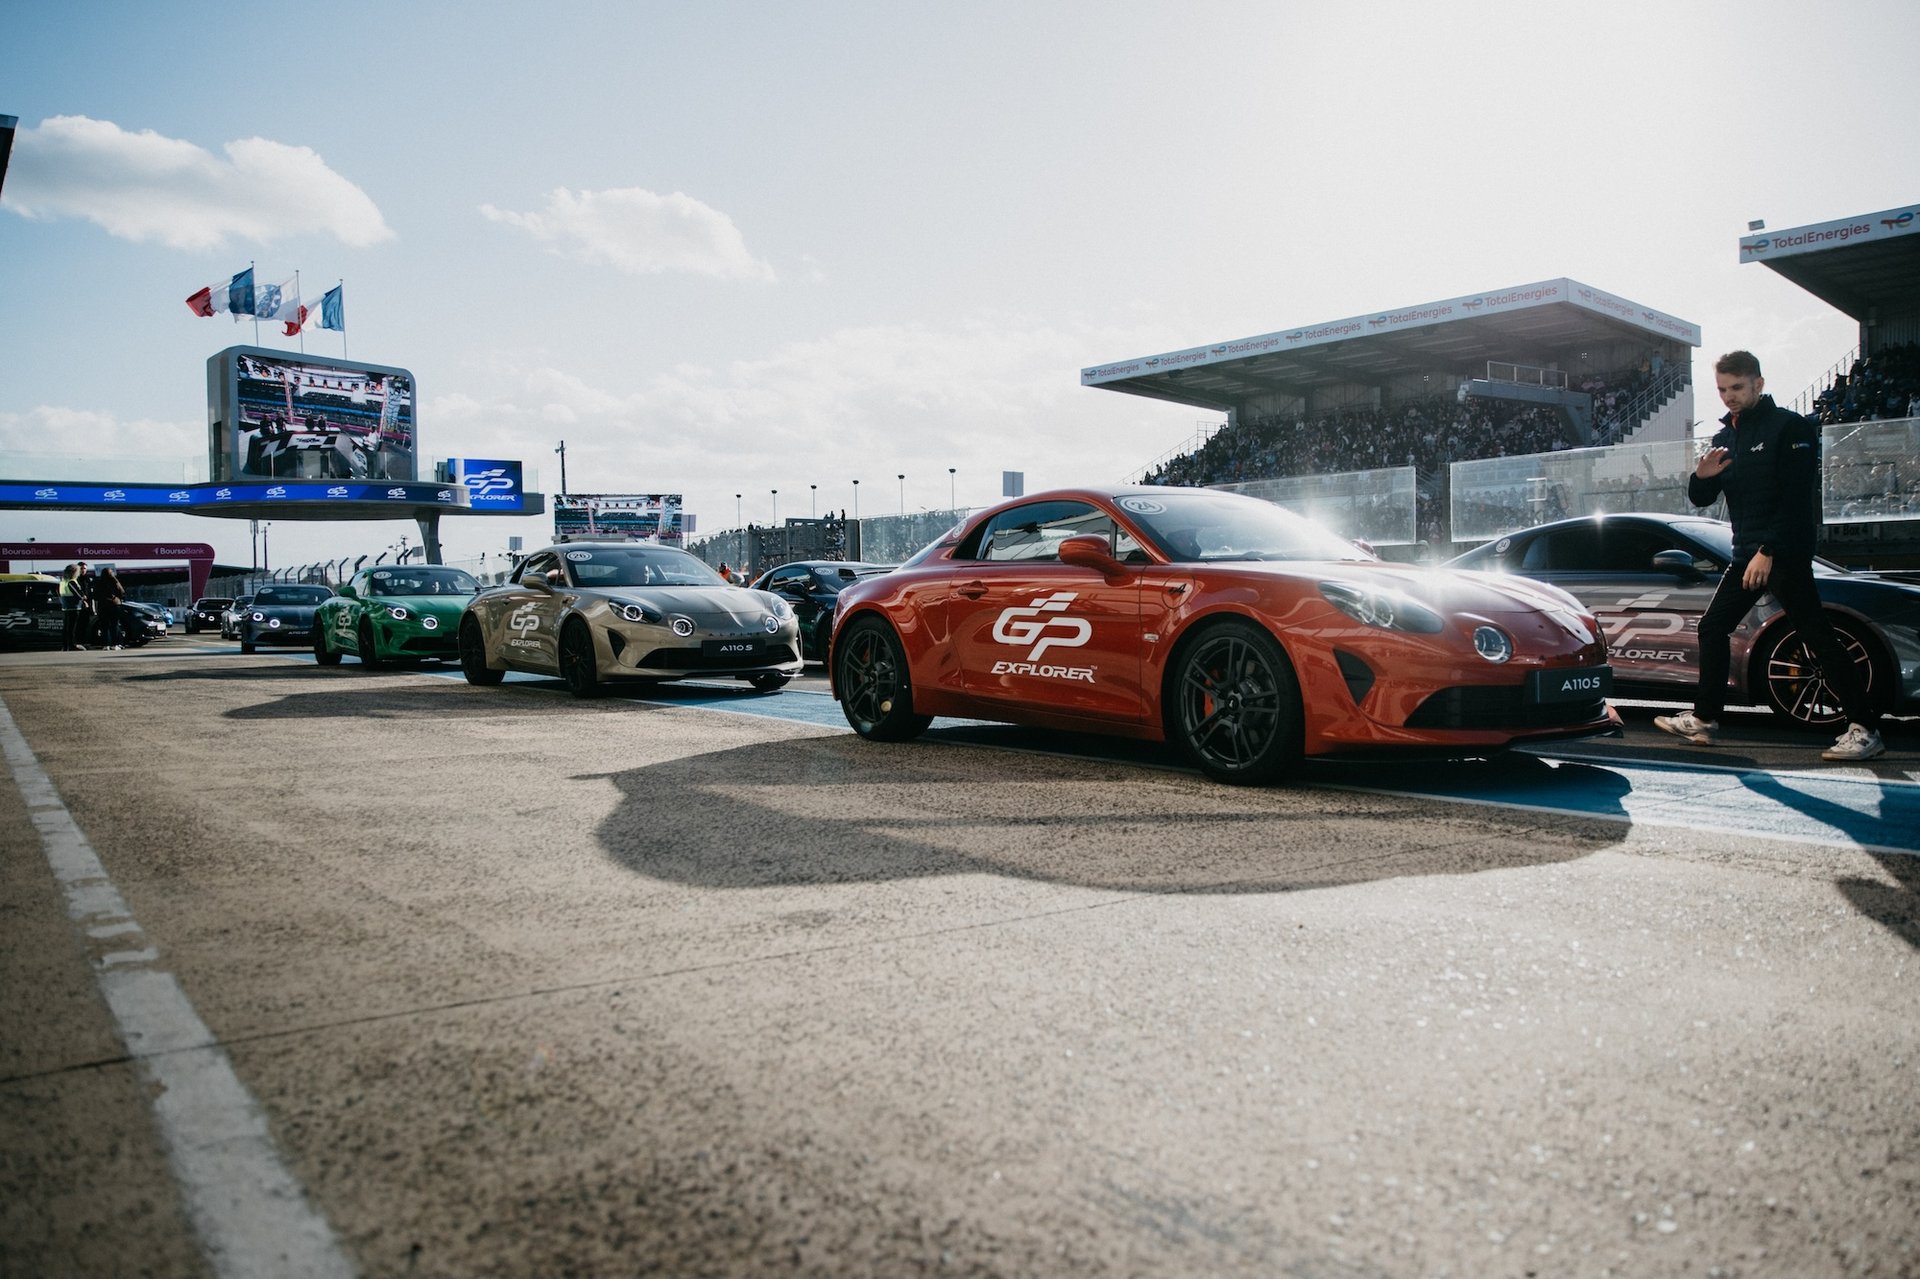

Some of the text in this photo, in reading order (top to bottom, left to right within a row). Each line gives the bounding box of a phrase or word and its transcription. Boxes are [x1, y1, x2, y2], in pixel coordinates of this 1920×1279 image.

[1772, 224, 1871, 249] TotalEnergies
[1484, 286, 1558, 308] TotalEnergies
[1592, 292, 1634, 318] TotalEnergies
[1388, 305, 1453, 325] TotalEnergies
[1303, 322, 1361, 341] TotalEnergies
[1654, 315, 1692, 338] TotalEnergies
[1227, 337, 1280, 355] TotalEnergies
[1160, 351, 1207, 367] TotalEnergies
[1097, 363, 1140, 377] TotalEnergies
[464, 472, 514, 495] GP
[469, 494, 515, 502] XPLORER
[1131, 501, 1156, 510] 24
[2, 547, 52, 555] BoursoBank
[83, 547, 130, 555] BoursoBank
[160, 547, 204, 555] BoursoBank
[510, 609, 541, 639] GP
[992, 606, 1093, 662] GP
[511, 638, 541, 649] EXPLORER
[990, 660, 1096, 684] EXPLORER
[1561, 676, 1600, 692] A110 S
